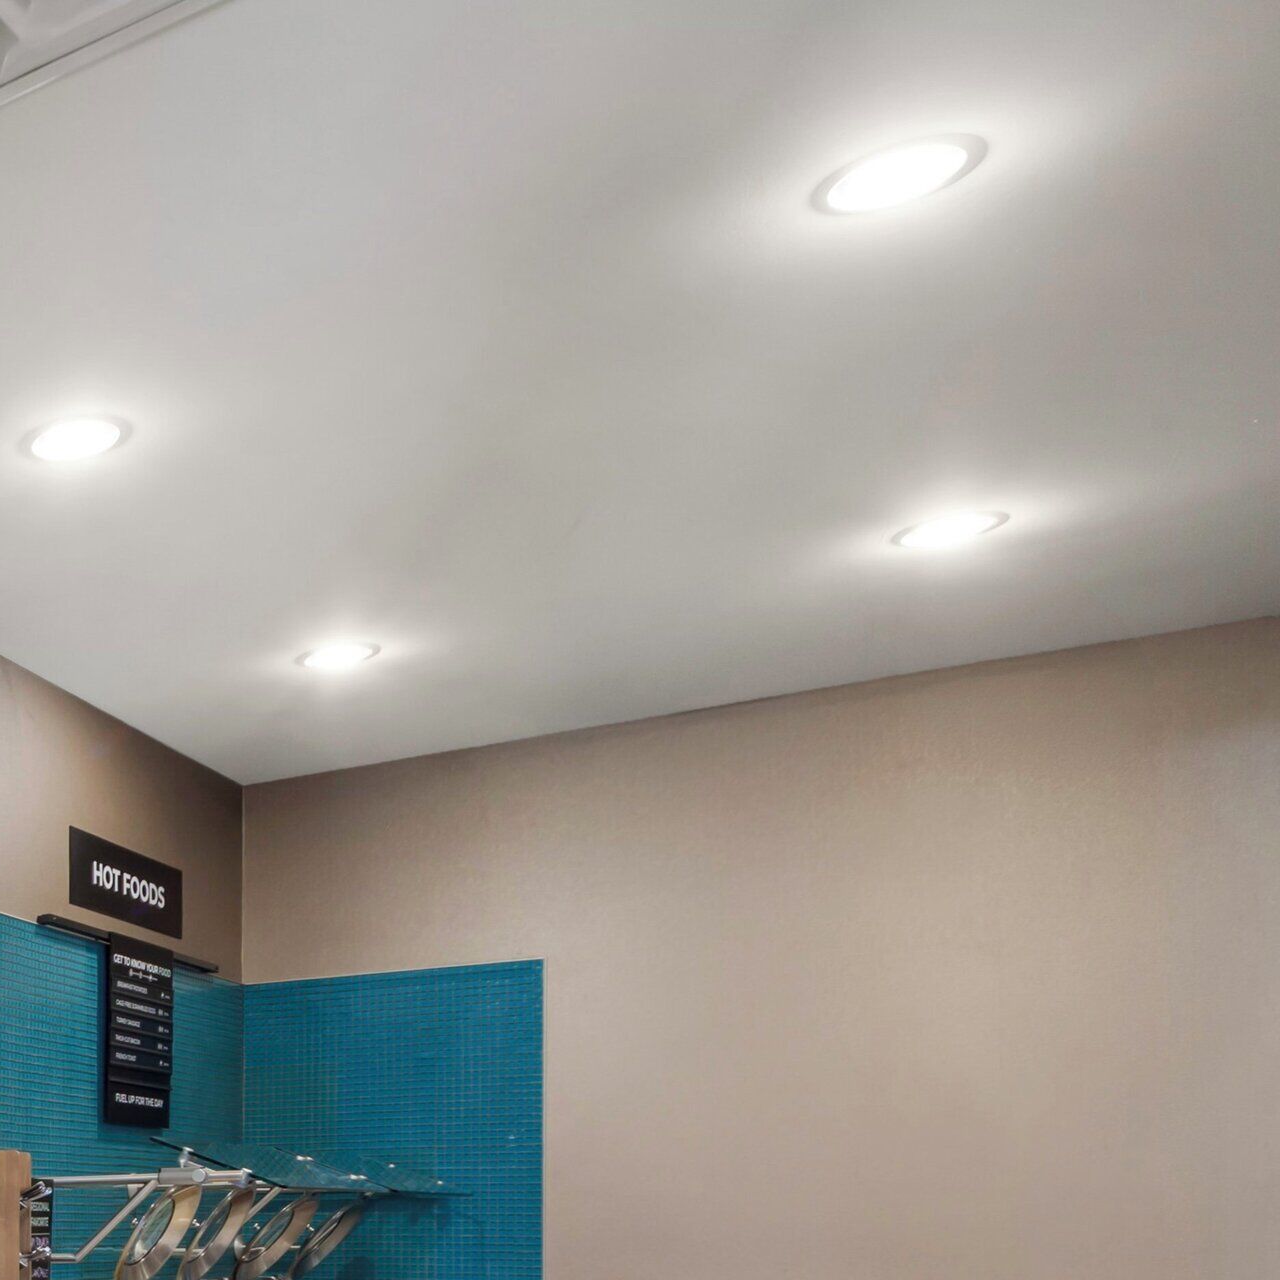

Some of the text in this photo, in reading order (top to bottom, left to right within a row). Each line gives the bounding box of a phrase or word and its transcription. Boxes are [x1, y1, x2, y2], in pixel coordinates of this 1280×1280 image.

[92, 861, 165, 909] HOT FOODS
[113, 954, 123, 964] GET
[123, 956, 130, 966] TO
